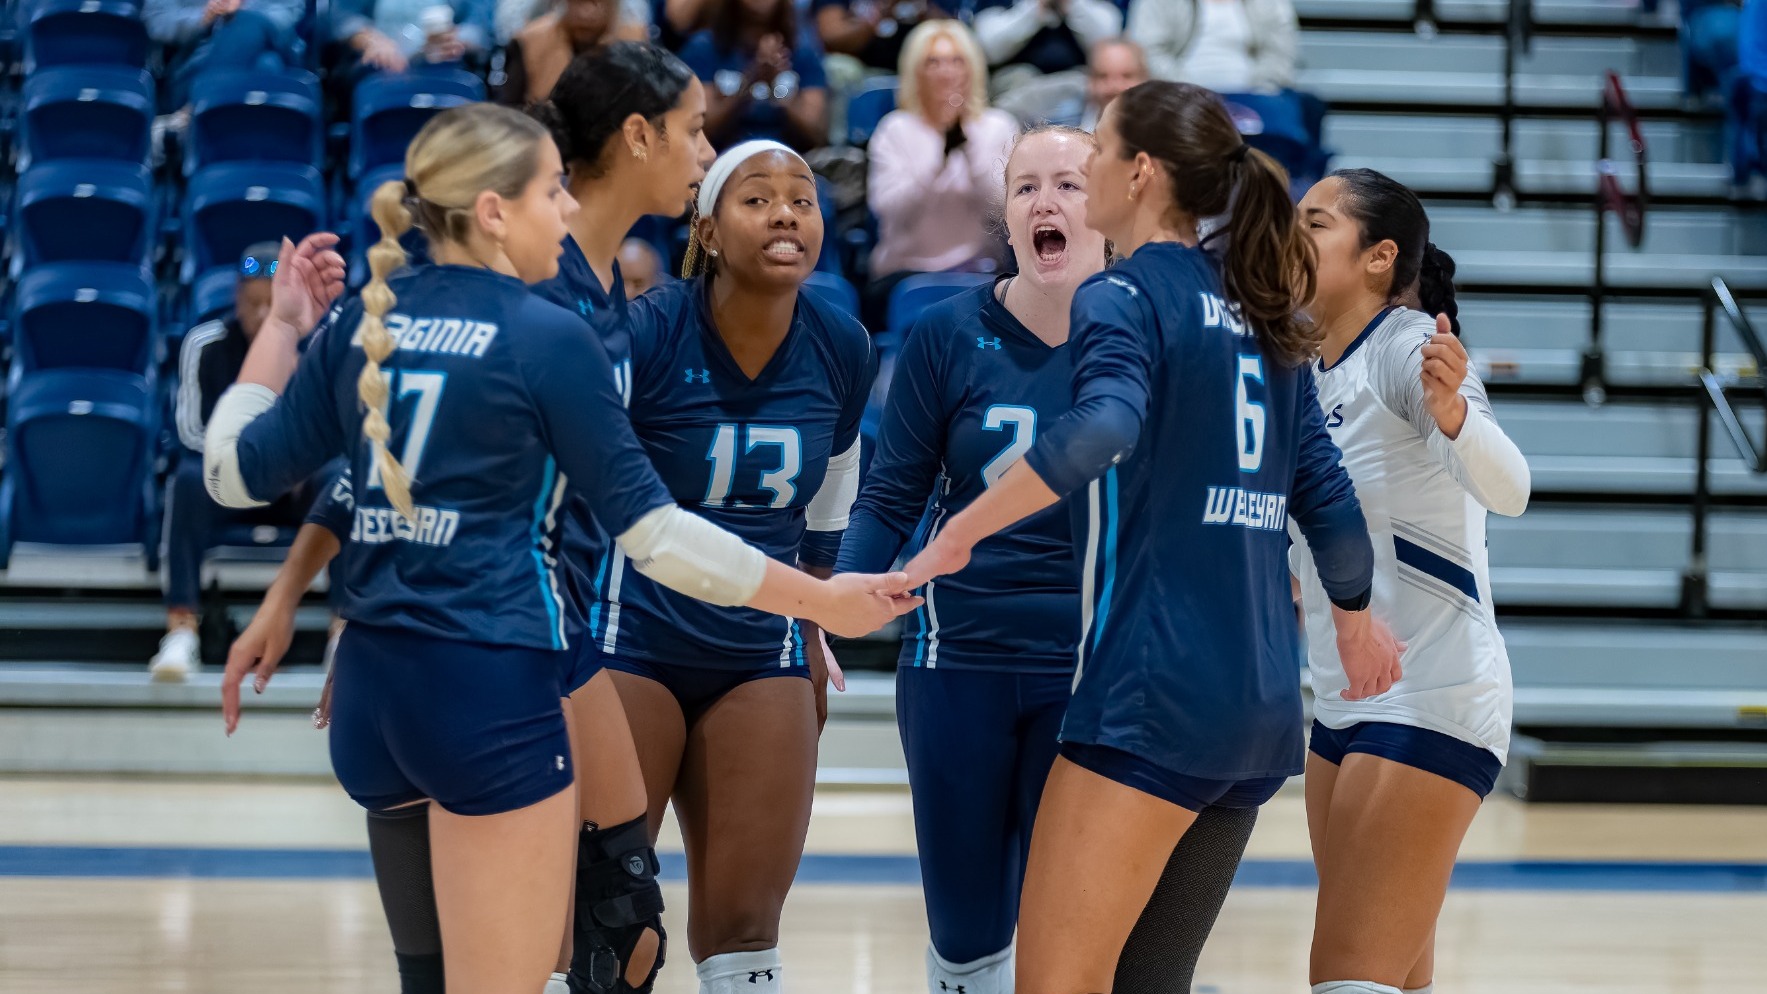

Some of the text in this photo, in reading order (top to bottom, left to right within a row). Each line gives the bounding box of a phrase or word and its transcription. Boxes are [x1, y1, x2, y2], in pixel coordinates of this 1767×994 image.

[366, 369, 448, 490] 17
[980, 404, 1037, 490] 2
[1234, 352, 1266, 473] 6
[704, 423, 802, 508] 13
